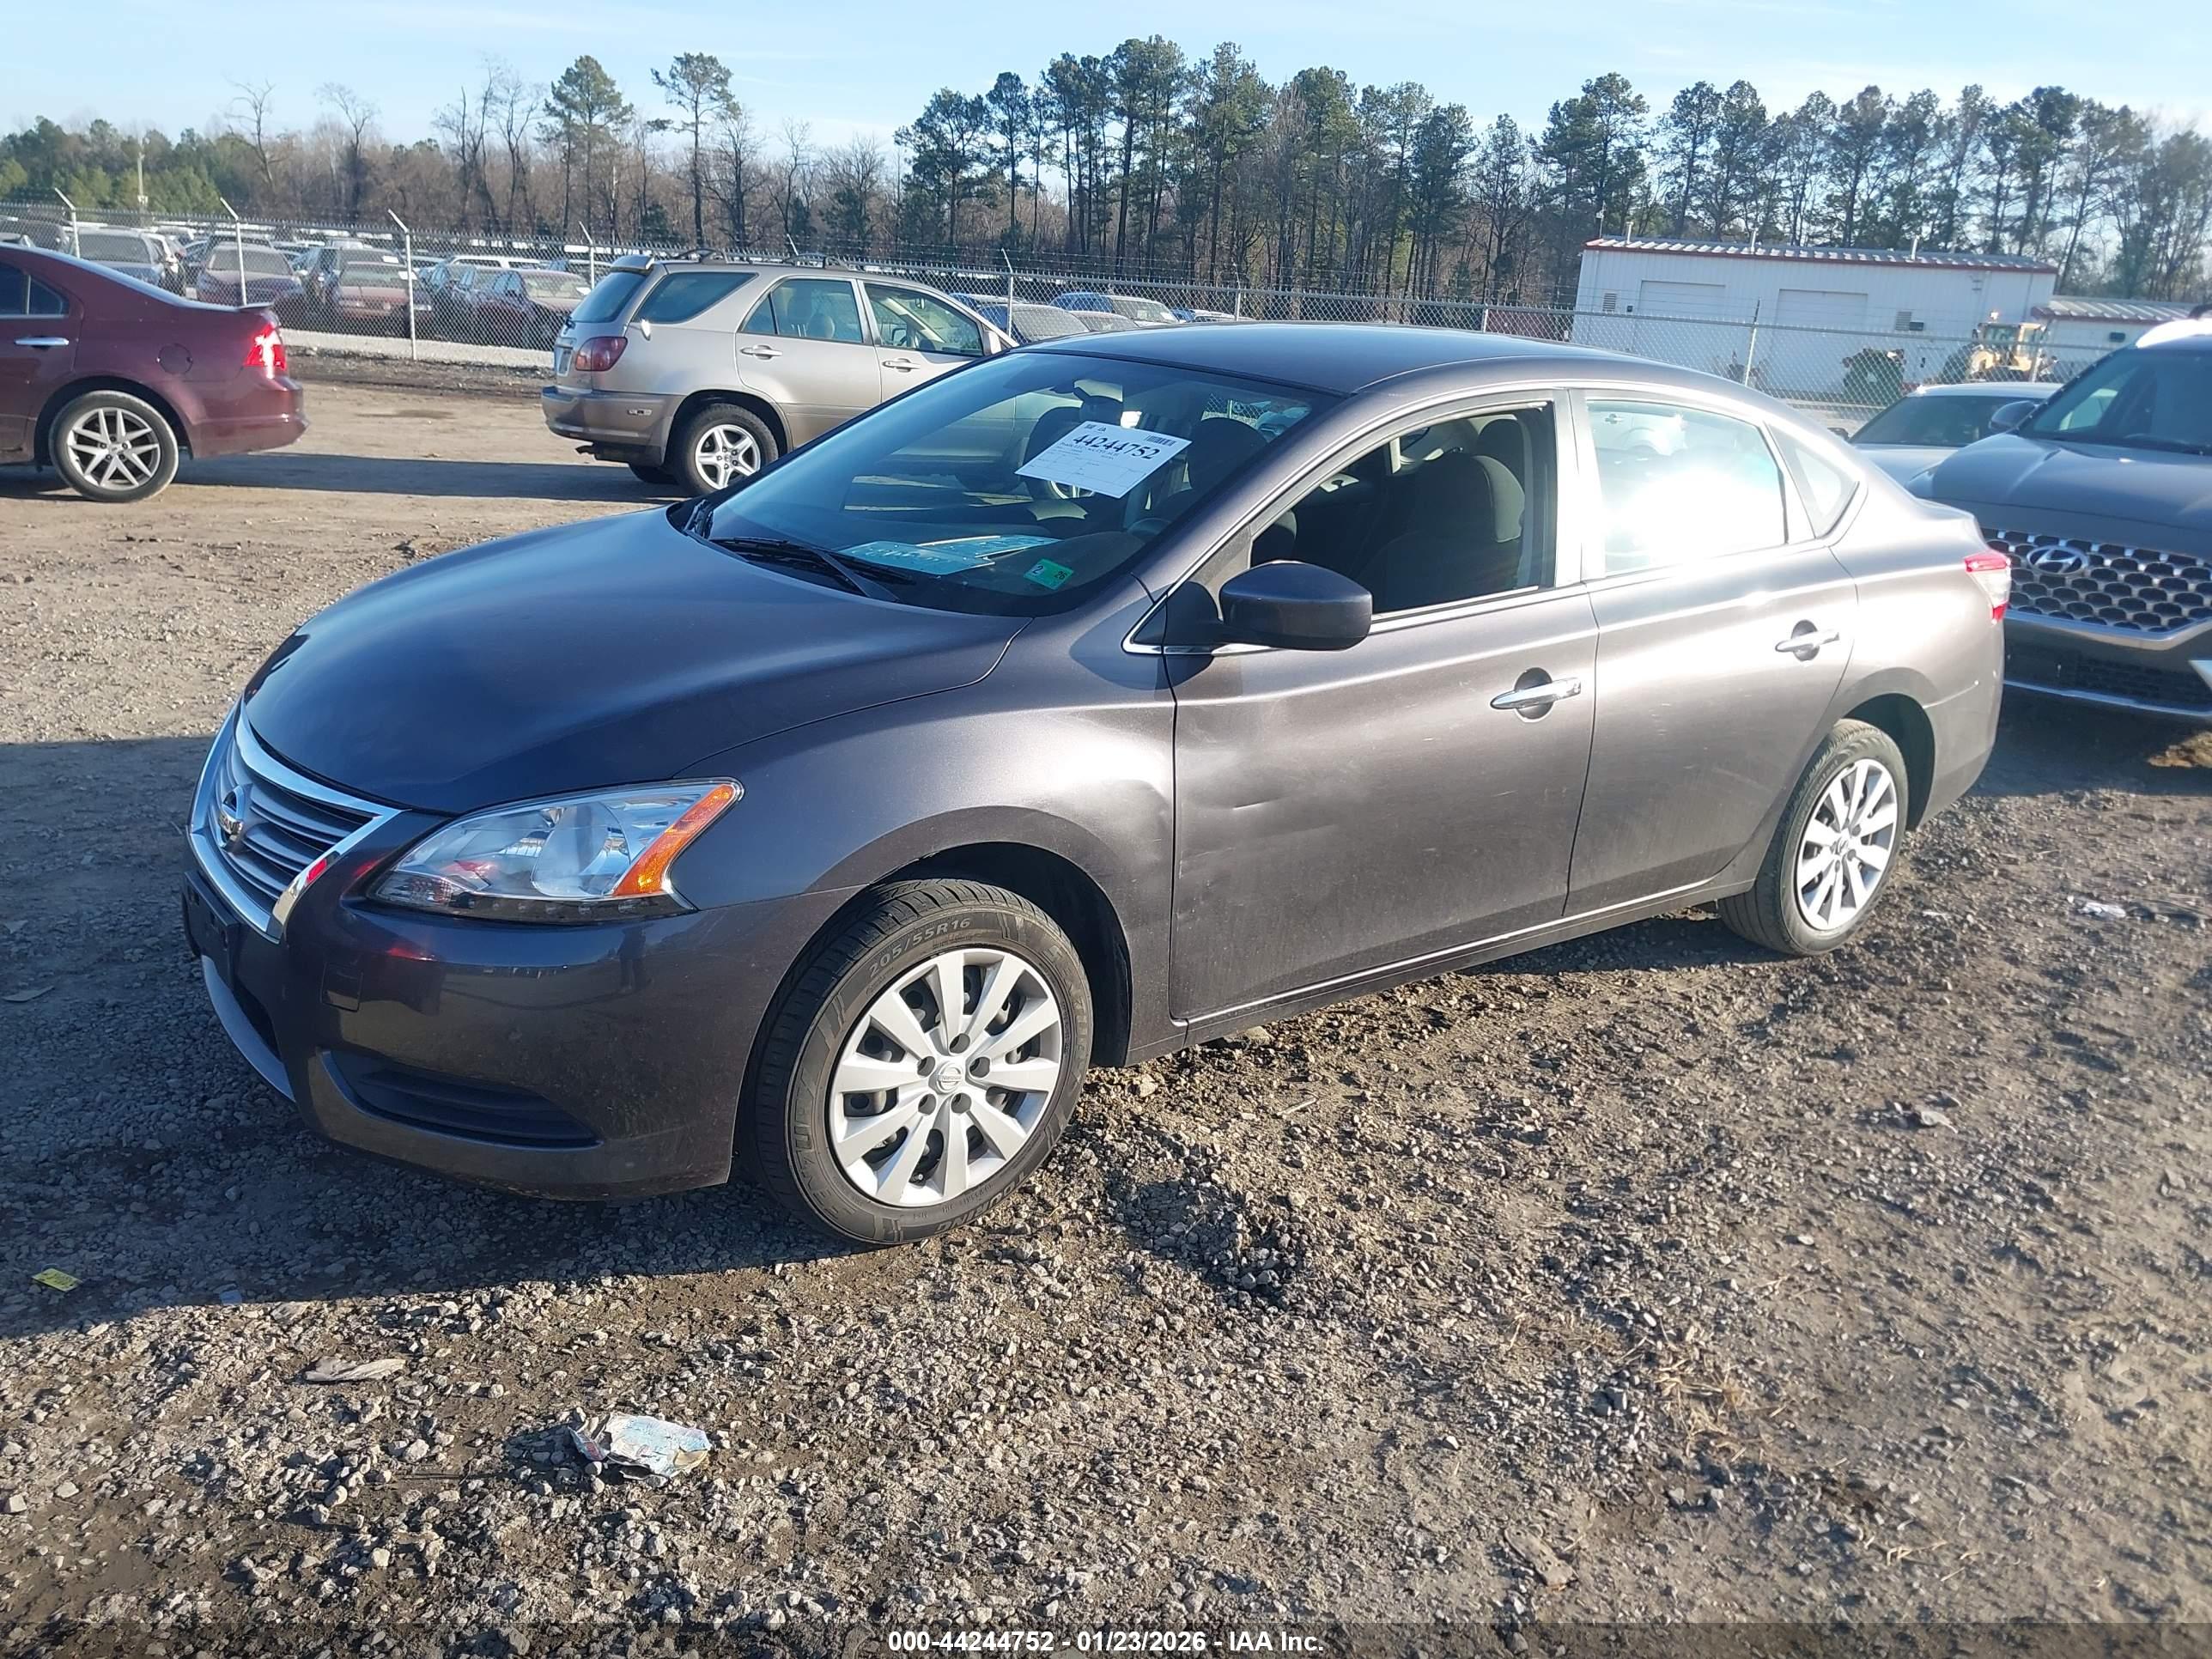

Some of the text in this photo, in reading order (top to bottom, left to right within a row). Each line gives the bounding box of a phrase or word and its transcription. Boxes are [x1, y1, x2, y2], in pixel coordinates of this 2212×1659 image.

[1073, 434, 1160, 459] 44244752
[1032, 565, 1044, 575] 2
[933, 1171, 1024, 1234] TOURING
